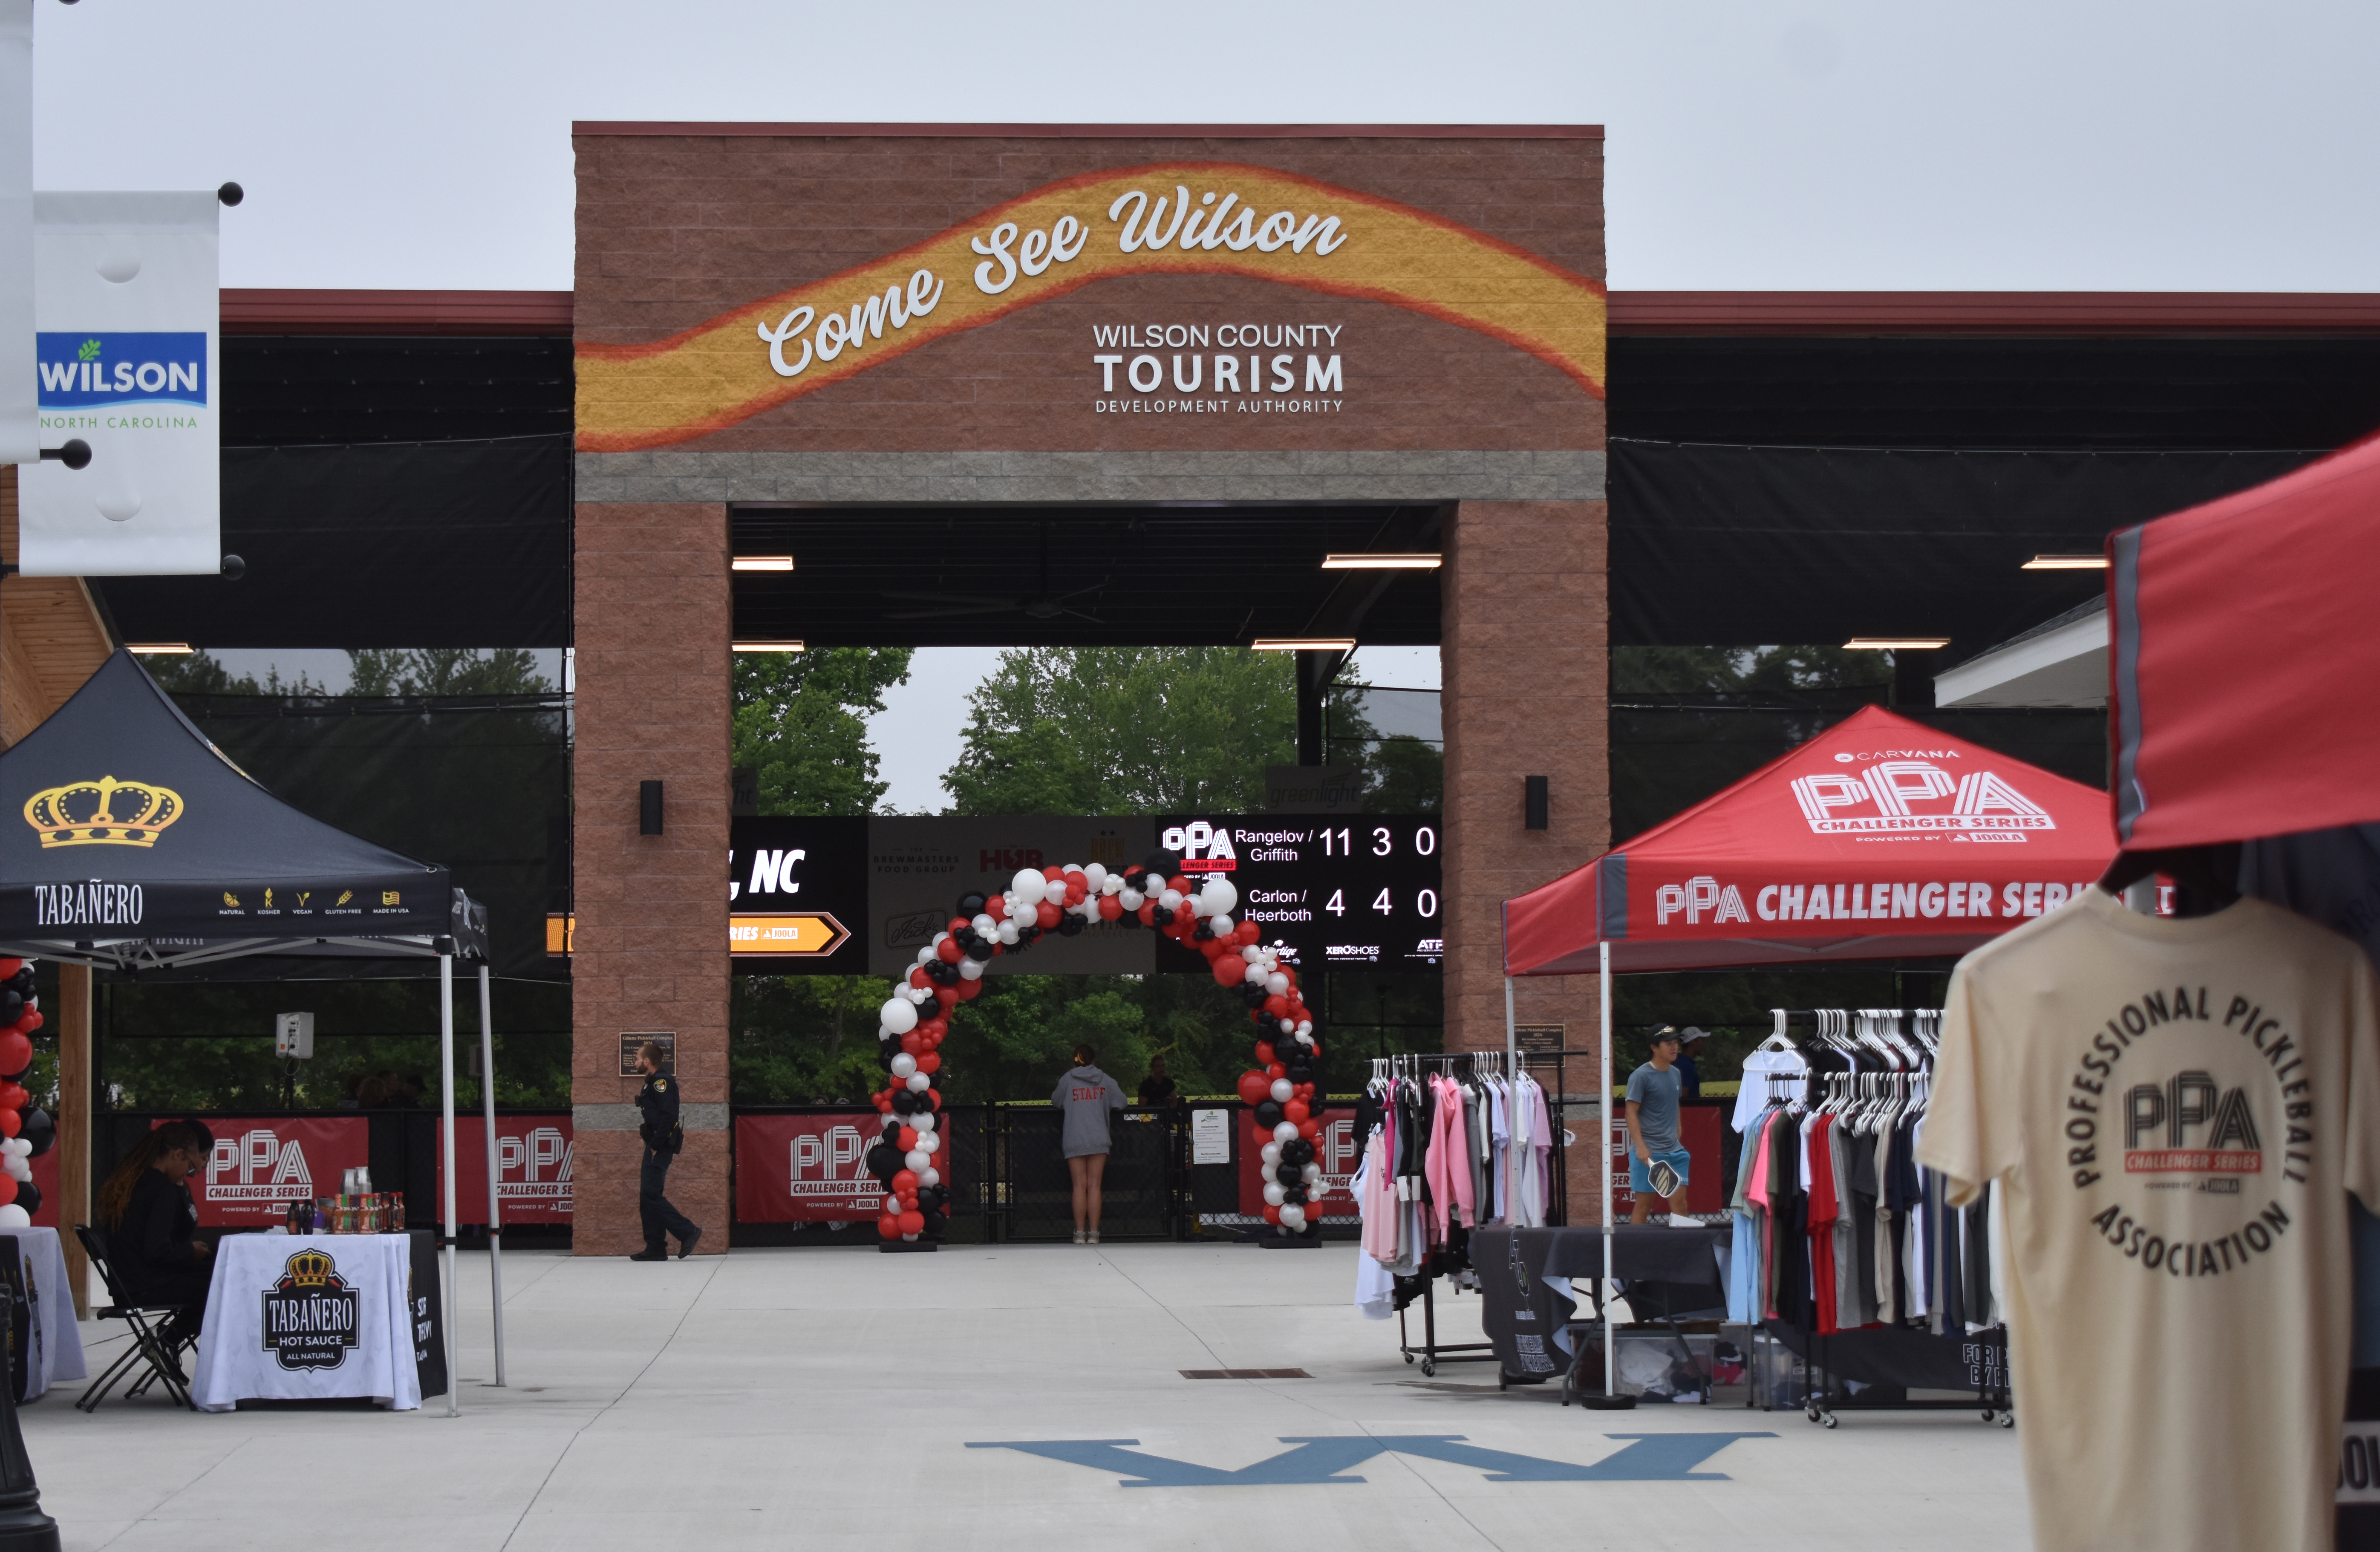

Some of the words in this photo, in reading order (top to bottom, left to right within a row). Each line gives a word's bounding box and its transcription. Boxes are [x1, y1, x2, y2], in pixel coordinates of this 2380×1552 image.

[758, 270, 943, 376] Come
[972, 216, 1088, 294] See
[1109, 186, 1347, 255] Wilson
[1093, 325, 1209, 347] WILSON
[1217, 325, 1342, 347] COUNTY
[39, 363, 197, 392] WILSON
[1094, 355, 1342, 392] TOURISM
[1096, 401, 1229, 413] DEVELOPMENT
[1238, 401, 1342, 413] AUTHORITY
[40, 418, 97, 428] NORTH
[107, 418, 197, 428] CAROLINA
[1857, 750, 1960, 760] CARVANA
[1269, 779, 1358, 808] greenlight
[1790, 762, 2048, 819] PPA
[1816, 818, 1961, 831] CHALLENGER
[1970, 817, 2047, 828] SERIES
[1974, 833, 2022, 841] JOOLA
[1163, 822, 1236, 860] PPA
[1236, 829, 1304, 846] Rangelov
[1308, 829, 1313, 842] /
[1320, 828, 1349, 856] 11
[1373, 827, 1391, 856] 3
[1416, 827, 1434, 856] 0
[980, 849, 1044, 873] HUB
[1251, 848, 1298, 861] Griffith
[749, 849, 805, 894] NC
[35, 879, 143, 924] TABAÑERO
[1249, 889, 1298, 903] Carlon
[1301, 889, 1307, 902] /
[1325, 889, 1345, 917] 4
[1372, 888, 1392, 915] 4
[1417, 889, 1436, 917] 0
[1656, 876, 1749, 925] PPA
[1756, 882, 1992, 921] CHALLENGER
[1245, 909, 1311, 922] Heerboth
[730, 927, 759, 940] RIES
[1072, 1086, 1106, 1102] STAFF
[2065, 986, 2209, 1189] PROFESSIONAL
[2222, 995, 2312, 1184] PICKLEBALL
[2123, 1070, 2260, 1150] PPA
[206, 1129, 313, 1184] PPA
[2126, 1155, 2209, 1170] CHALLENGER
[2213, 1155, 2258, 1169] SERIES
[209, 1187, 273, 1198] CHALLENGER
[276, 1187, 310, 1197] SERIES
[793, 1183, 857, 1194] CHALLENGER
[860, 1182, 884, 1192] SERI
[2090, 1200, 2291, 1277] ASSOCIATION
[269, 1293, 353, 1333] TABAÑERO
[279, 1336, 303, 1346] HOT
[305, 1335, 343, 1345] SAUCE
